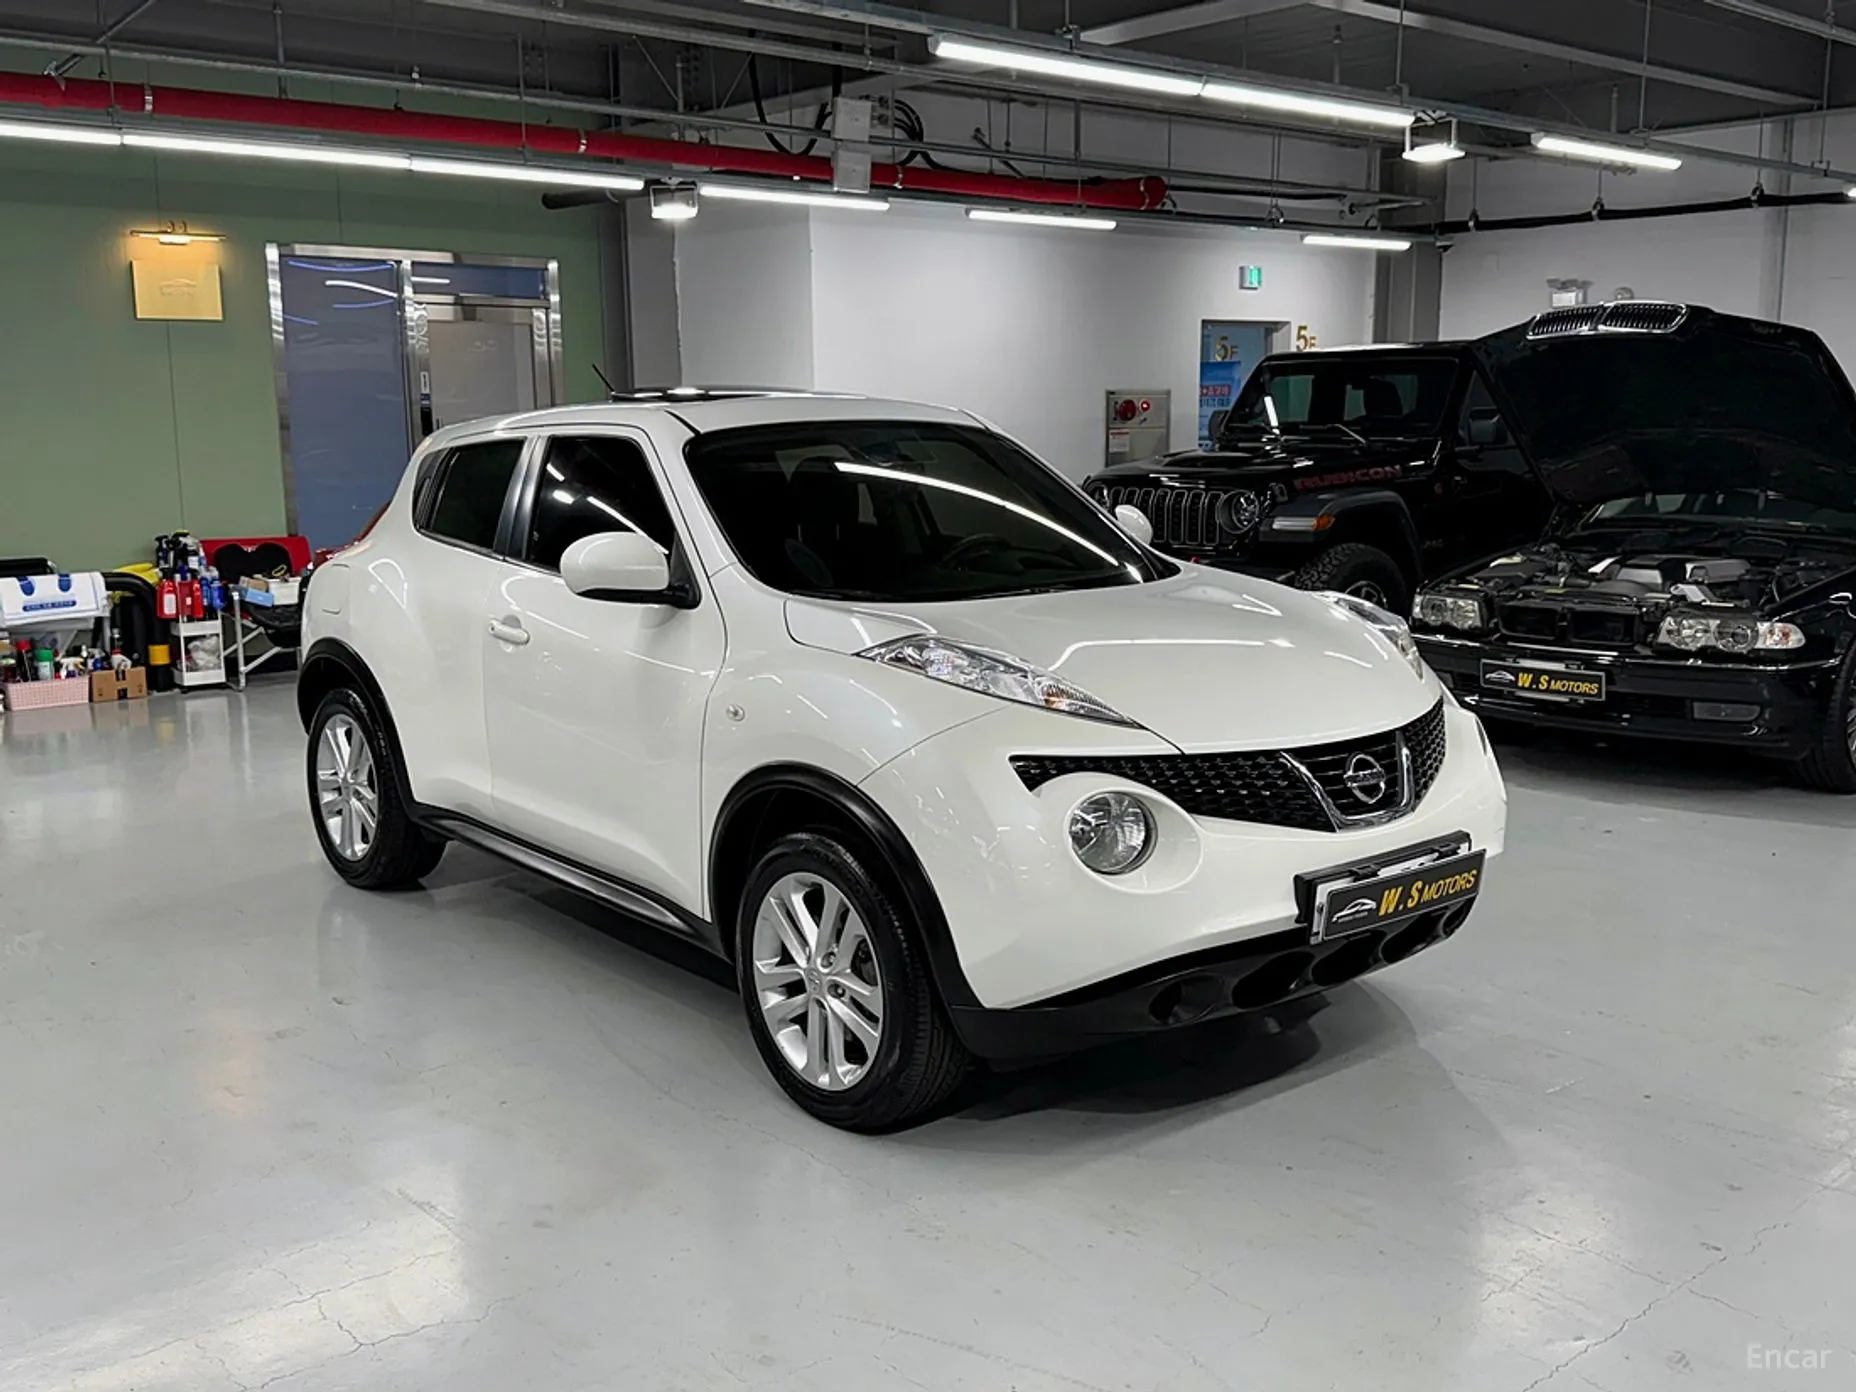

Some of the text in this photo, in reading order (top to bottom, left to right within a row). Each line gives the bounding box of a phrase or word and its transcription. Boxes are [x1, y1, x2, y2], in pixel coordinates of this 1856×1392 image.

[1214, 336, 1238, 361] 5F
[1296, 325, 1317, 352] 5F
[1295, 465, 1402, 490] RUBICON
[1550, 680, 1600, 695] MOTORS
[1421, 869, 1478, 903] MOTORS
